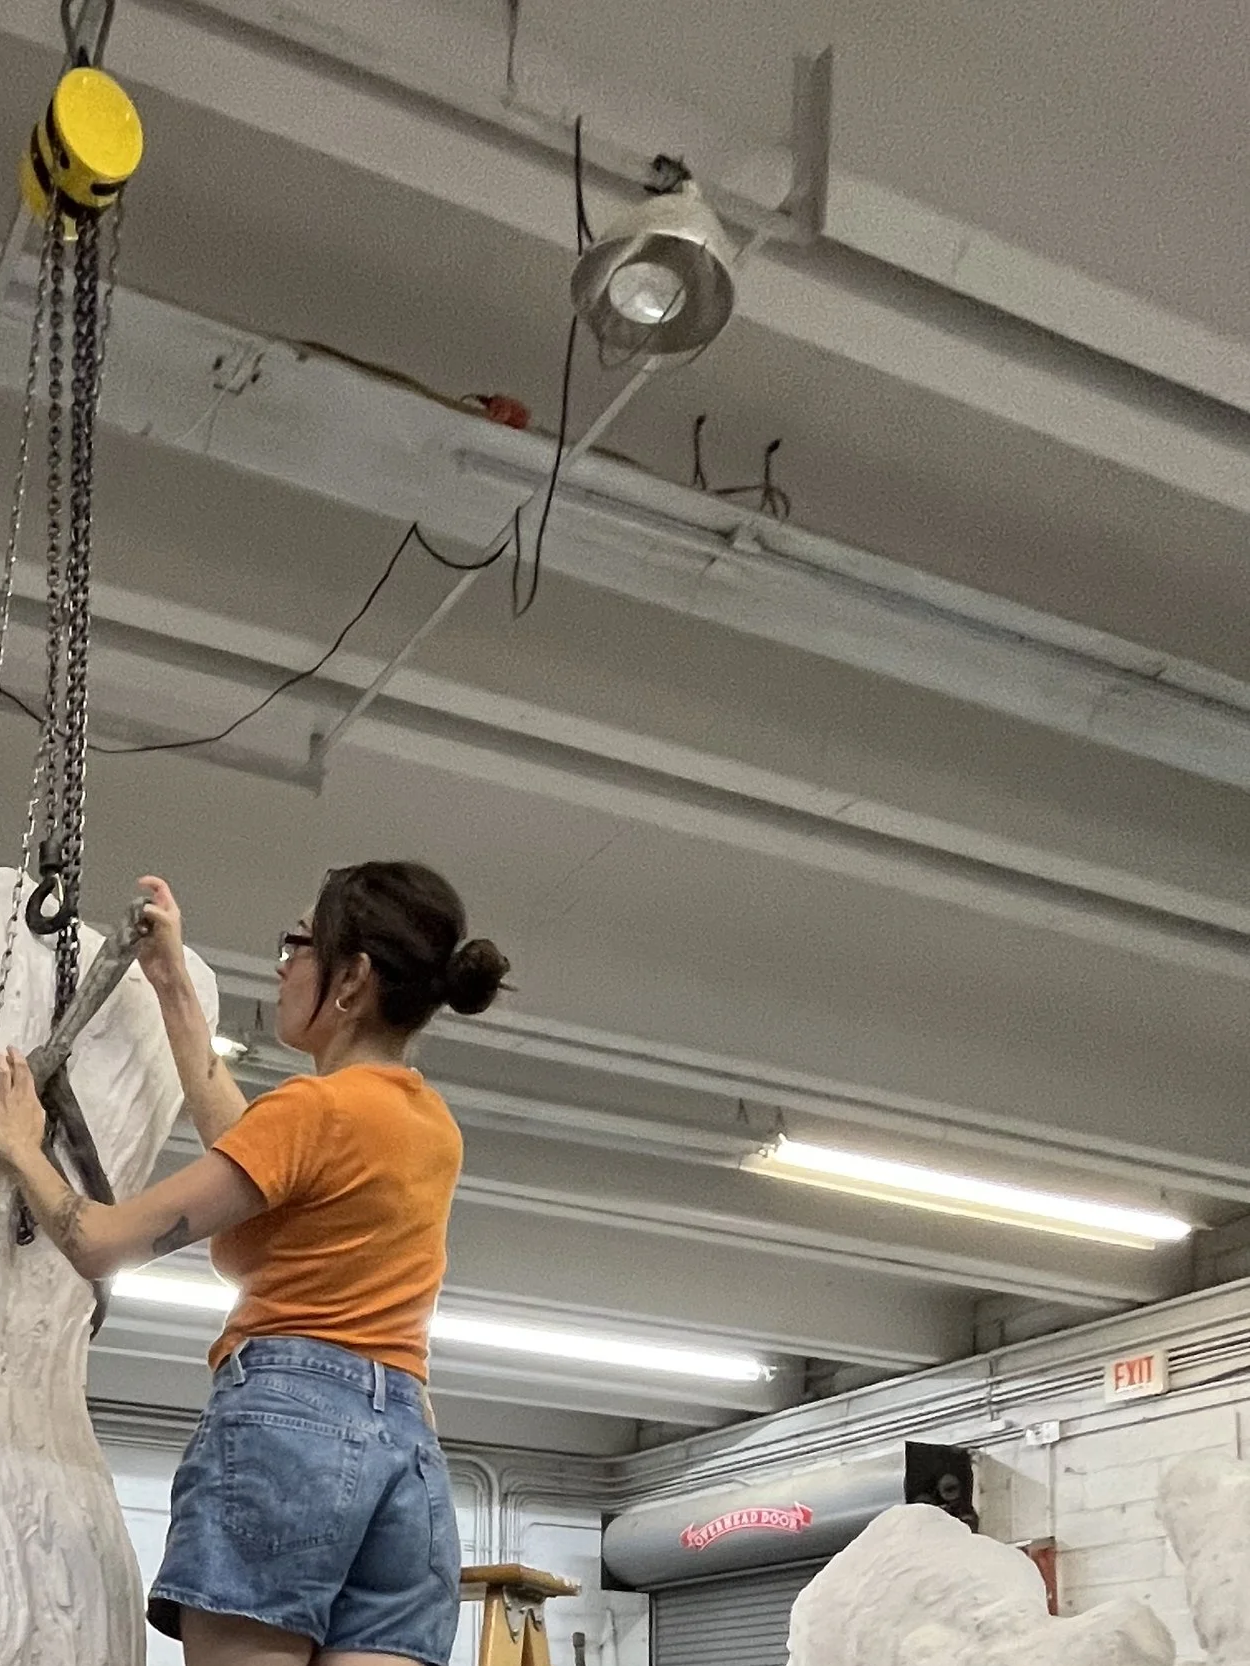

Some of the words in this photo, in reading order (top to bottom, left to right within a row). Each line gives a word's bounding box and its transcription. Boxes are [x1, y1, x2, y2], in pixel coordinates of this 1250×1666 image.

[1114, 1355, 1154, 1391] EXIT
[693, 1511, 759, 1546] OVERHEAD
[761, 1511, 799, 1530] DOOR
